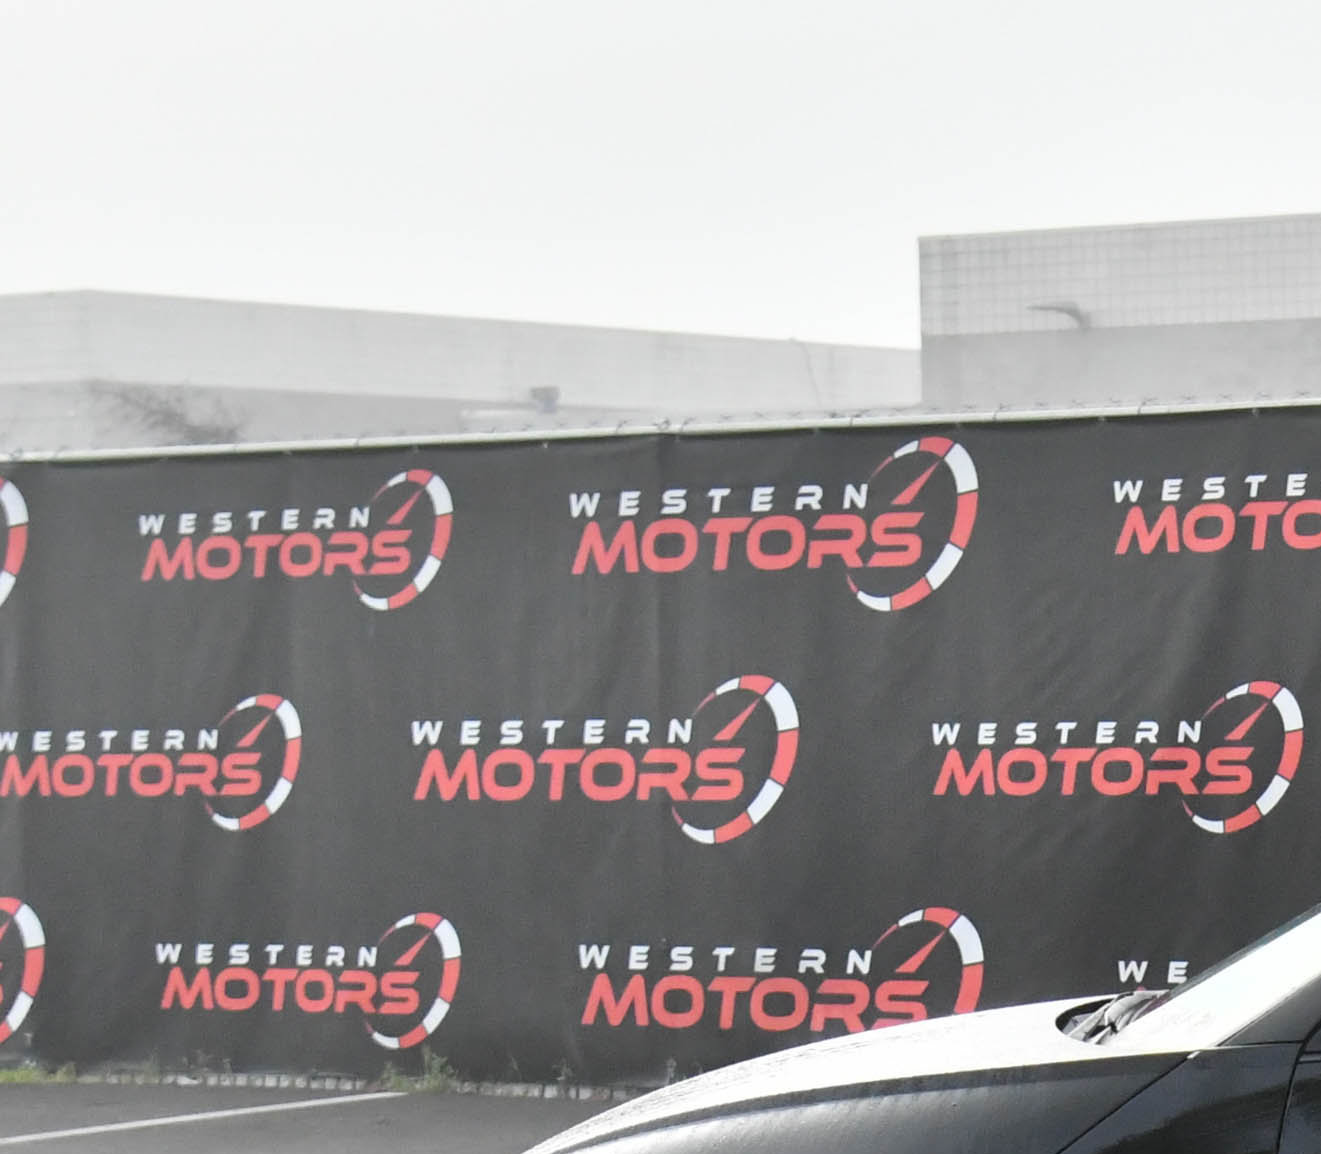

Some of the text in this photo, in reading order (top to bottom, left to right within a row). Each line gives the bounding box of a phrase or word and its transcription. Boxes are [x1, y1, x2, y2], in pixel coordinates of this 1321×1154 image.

[138, 506, 370, 536] WESTERN
[569, 483, 869, 519] WESTERN
[142, 529, 412, 581] MOTORS
[572, 511, 925, 575] MOTORS
[0, 728, 219, 753] WESTERN
[410, 718, 694, 746] WESTERN
[931, 719, 1203, 746] WESTERN
[0, 751, 262, 798] MOTORS
[413, 745, 746, 802] MOTORS
[932, 745, 1255, 797] MOTORS
[155, 943, 378, 968] WESTERN
[578, 944, 873, 976] WESTERN
[160, 966, 420, 1015] MOTORS
[580, 972, 930, 1034] MOTORS
